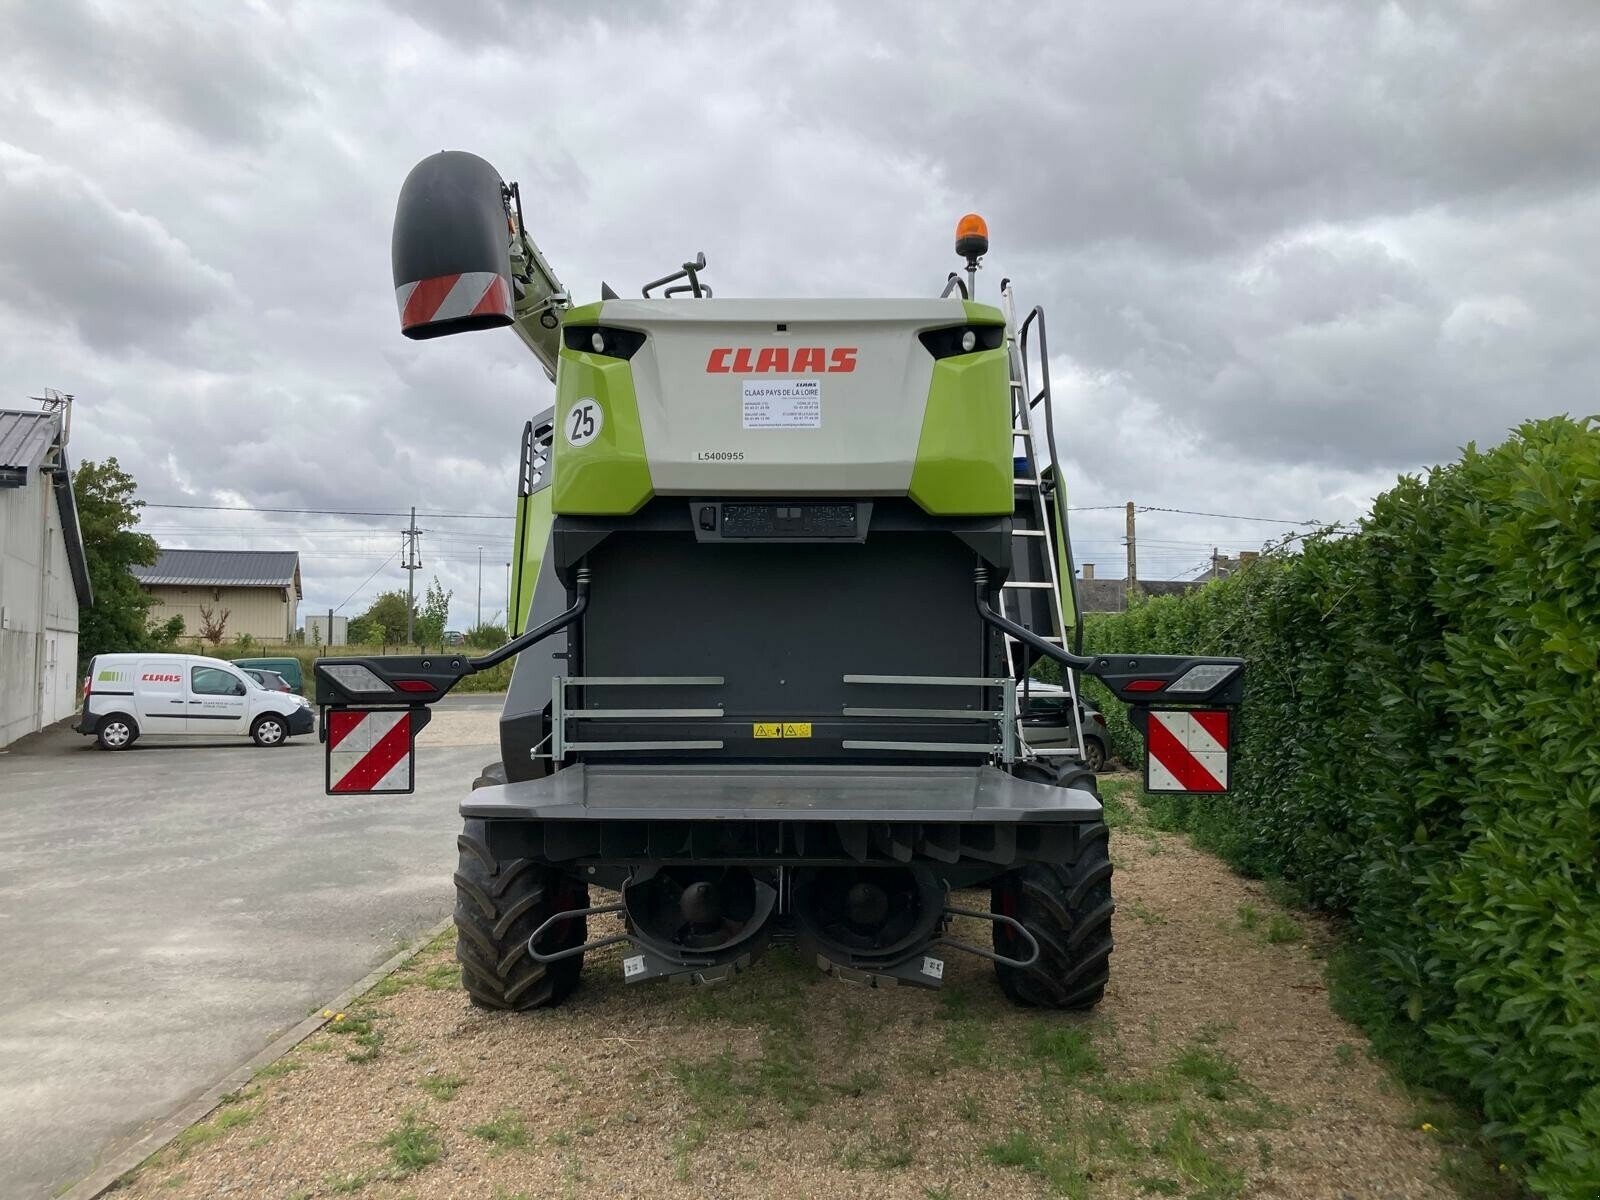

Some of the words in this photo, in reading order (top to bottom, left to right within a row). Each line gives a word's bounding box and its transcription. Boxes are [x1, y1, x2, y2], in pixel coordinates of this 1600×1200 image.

[706, 348, 858, 373] CLAAS
[571, 405, 595, 441] 25
[698, 452, 744, 461] L5400955
[142, 673, 182, 682] CLAAS
